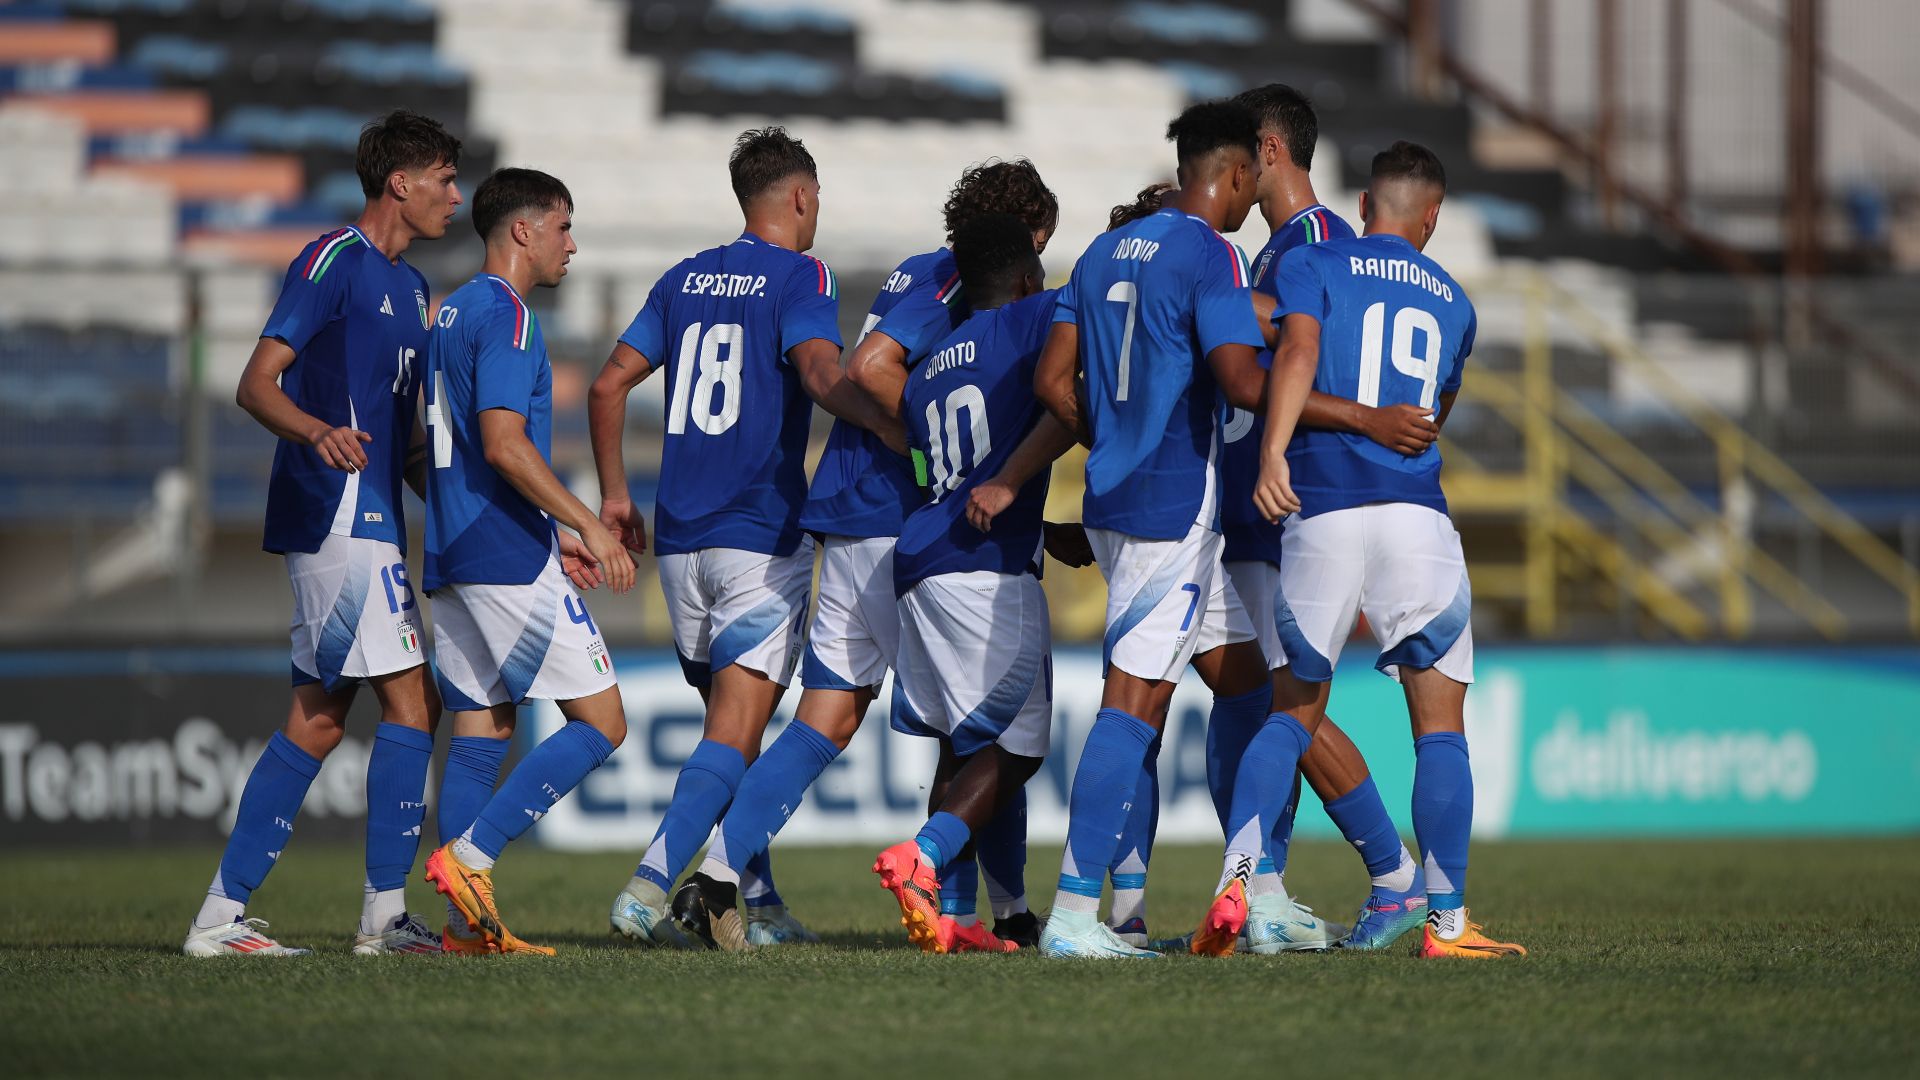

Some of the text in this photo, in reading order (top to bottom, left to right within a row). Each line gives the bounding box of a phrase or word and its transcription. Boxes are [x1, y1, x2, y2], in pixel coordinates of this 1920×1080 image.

[1112, 237, 1160, 263] NDOUR
[1350, 256, 1454, 303] RAIMONDO
[925, 340, 976, 380] GNONTO
[1106, 280, 1138, 402] 7
[1357, 302, 1442, 422] 19
[668, 321, 744, 435] 18
[926, 384, 992, 505] 10
[380, 562, 415, 615] 15
[563, 593, 598, 636] 4
[1180, 582, 1201, 632] 7
[0, 717, 434, 838] TeamSye
